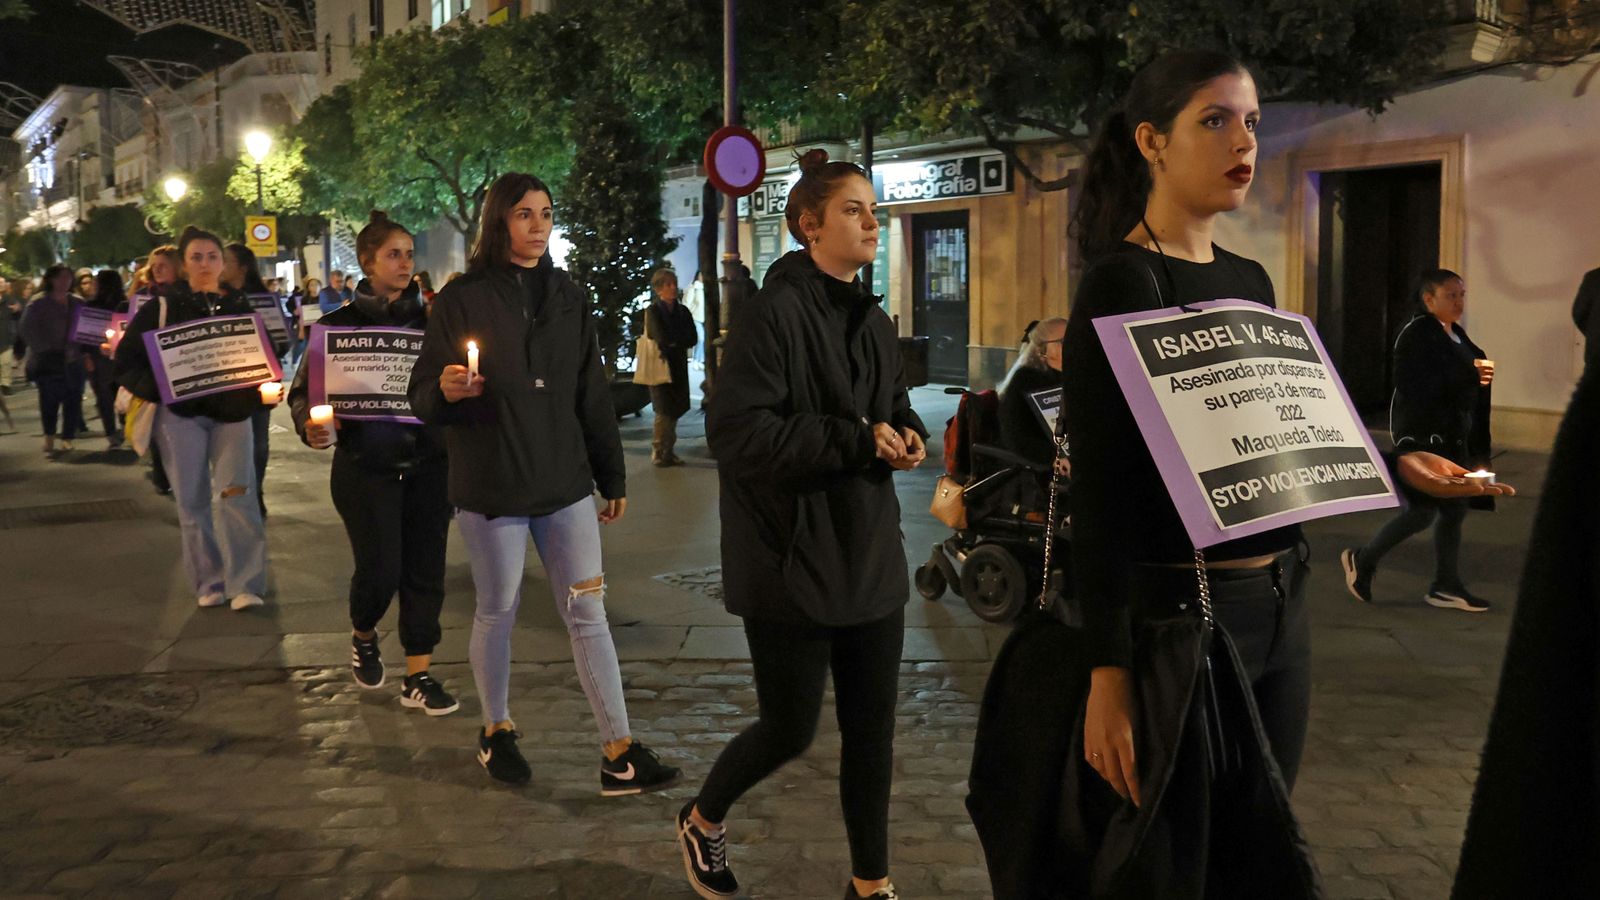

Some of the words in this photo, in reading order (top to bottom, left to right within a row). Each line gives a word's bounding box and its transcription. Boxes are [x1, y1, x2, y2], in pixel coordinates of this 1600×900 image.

[883, 174, 977, 201] Fotografía
[159, 328, 209, 346] CLAUDIA
[336, 337, 373, 348] MARI
[375, 337, 389, 348] A.
[392, 338, 408, 349] 46
[1152, 324, 1245, 360] ISABEL
[1241, 323, 1262, 344] V.
[1262, 324, 1280, 346] 45
[1279, 329, 1309, 351] años
[332, 354, 382, 362] Asesinada
[383, 355, 398, 363] por
[357, 364, 390, 372] marido
[1169, 362, 1255, 393] Asesinada
[1255, 363, 1277, 382] por
[1276, 361, 1314, 381] disparos
[1313, 367, 1326, 380] de
[386, 374, 408, 382] 2022
[329, 400, 358, 409] STOP
[358, 400, 412, 410] VIOLENCIA
[1204, 396, 1228, 411] su
[1228, 383, 1277, 409] pareja
[1274, 382, 1285, 398] 3
[1285, 382, 1300, 398] de
[1300, 385, 1327, 400] marzo
[1275, 404, 1306, 422] 2022
[1231, 426, 1311, 456] Maqueda
[1307, 425, 1345, 443] Toledo
[1211, 478, 1263, 508] STOP
[1261, 463, 1338, 494] VIOLENCIA
[1334, 463, 1378, 481] MACHISTA
